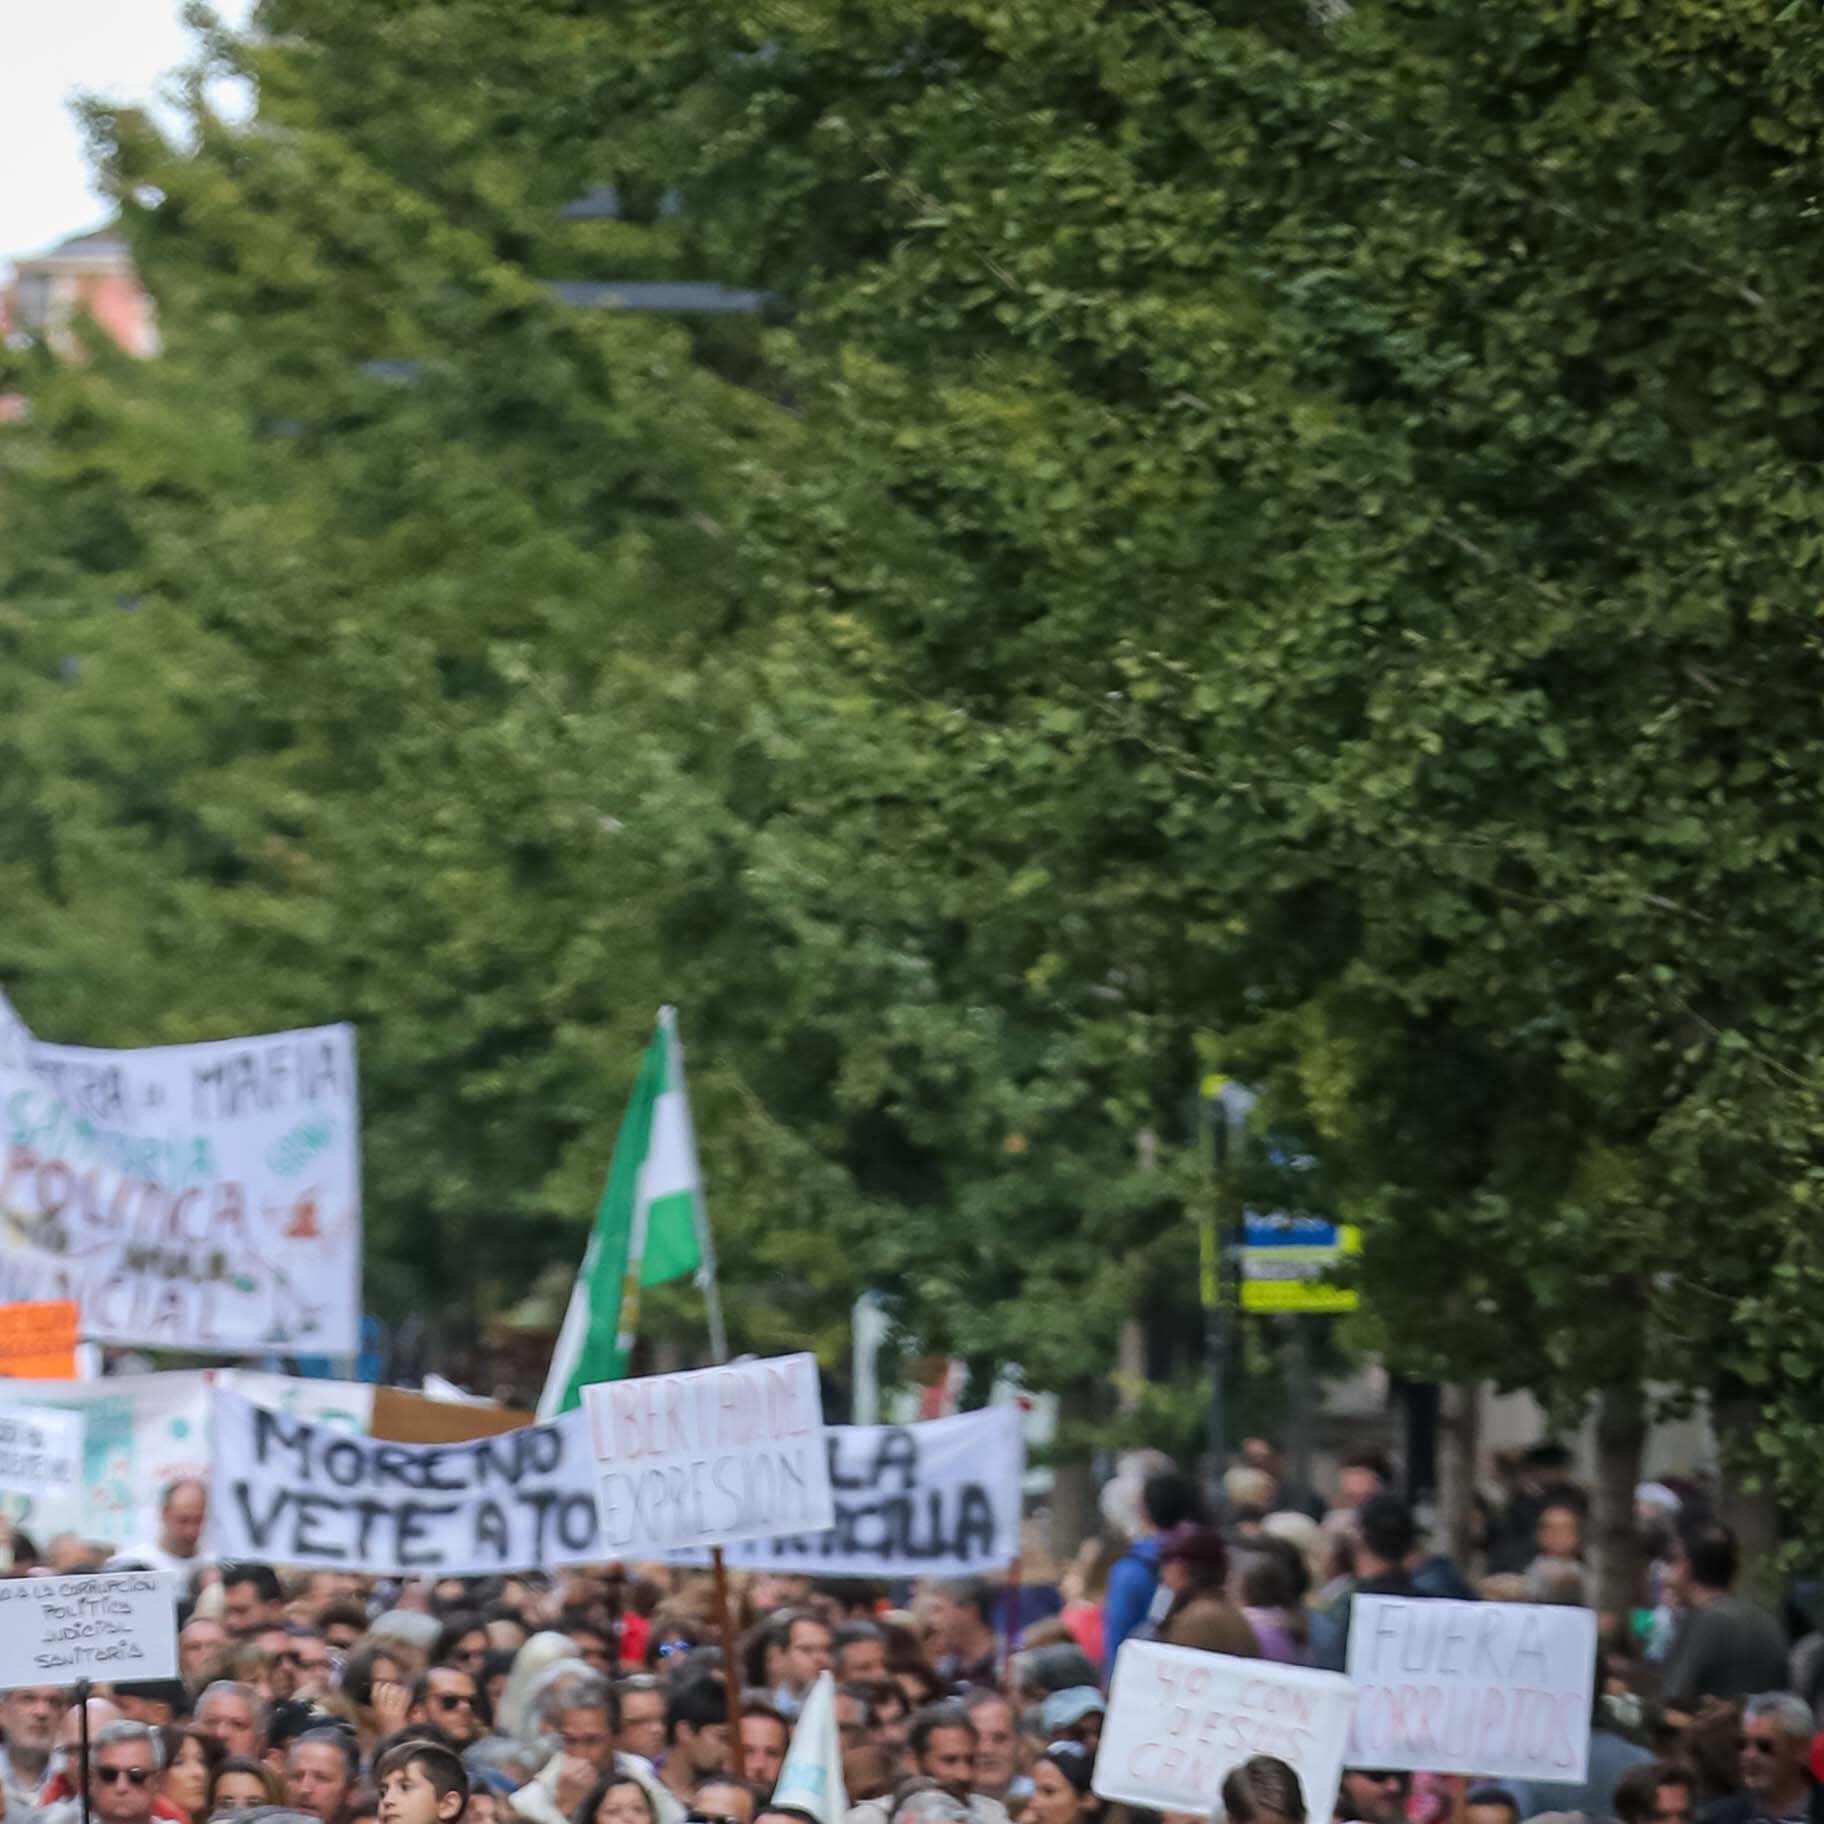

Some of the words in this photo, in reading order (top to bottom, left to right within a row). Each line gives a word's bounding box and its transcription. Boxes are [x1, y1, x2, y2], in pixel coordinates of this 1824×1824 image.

[253, 1407, 563, 1490] MORENO
[233, 1480, 458, 1566] VETE
[475, 1499, 511, 1561] A
[1375, 1603, 1550, 1679] FUERA
